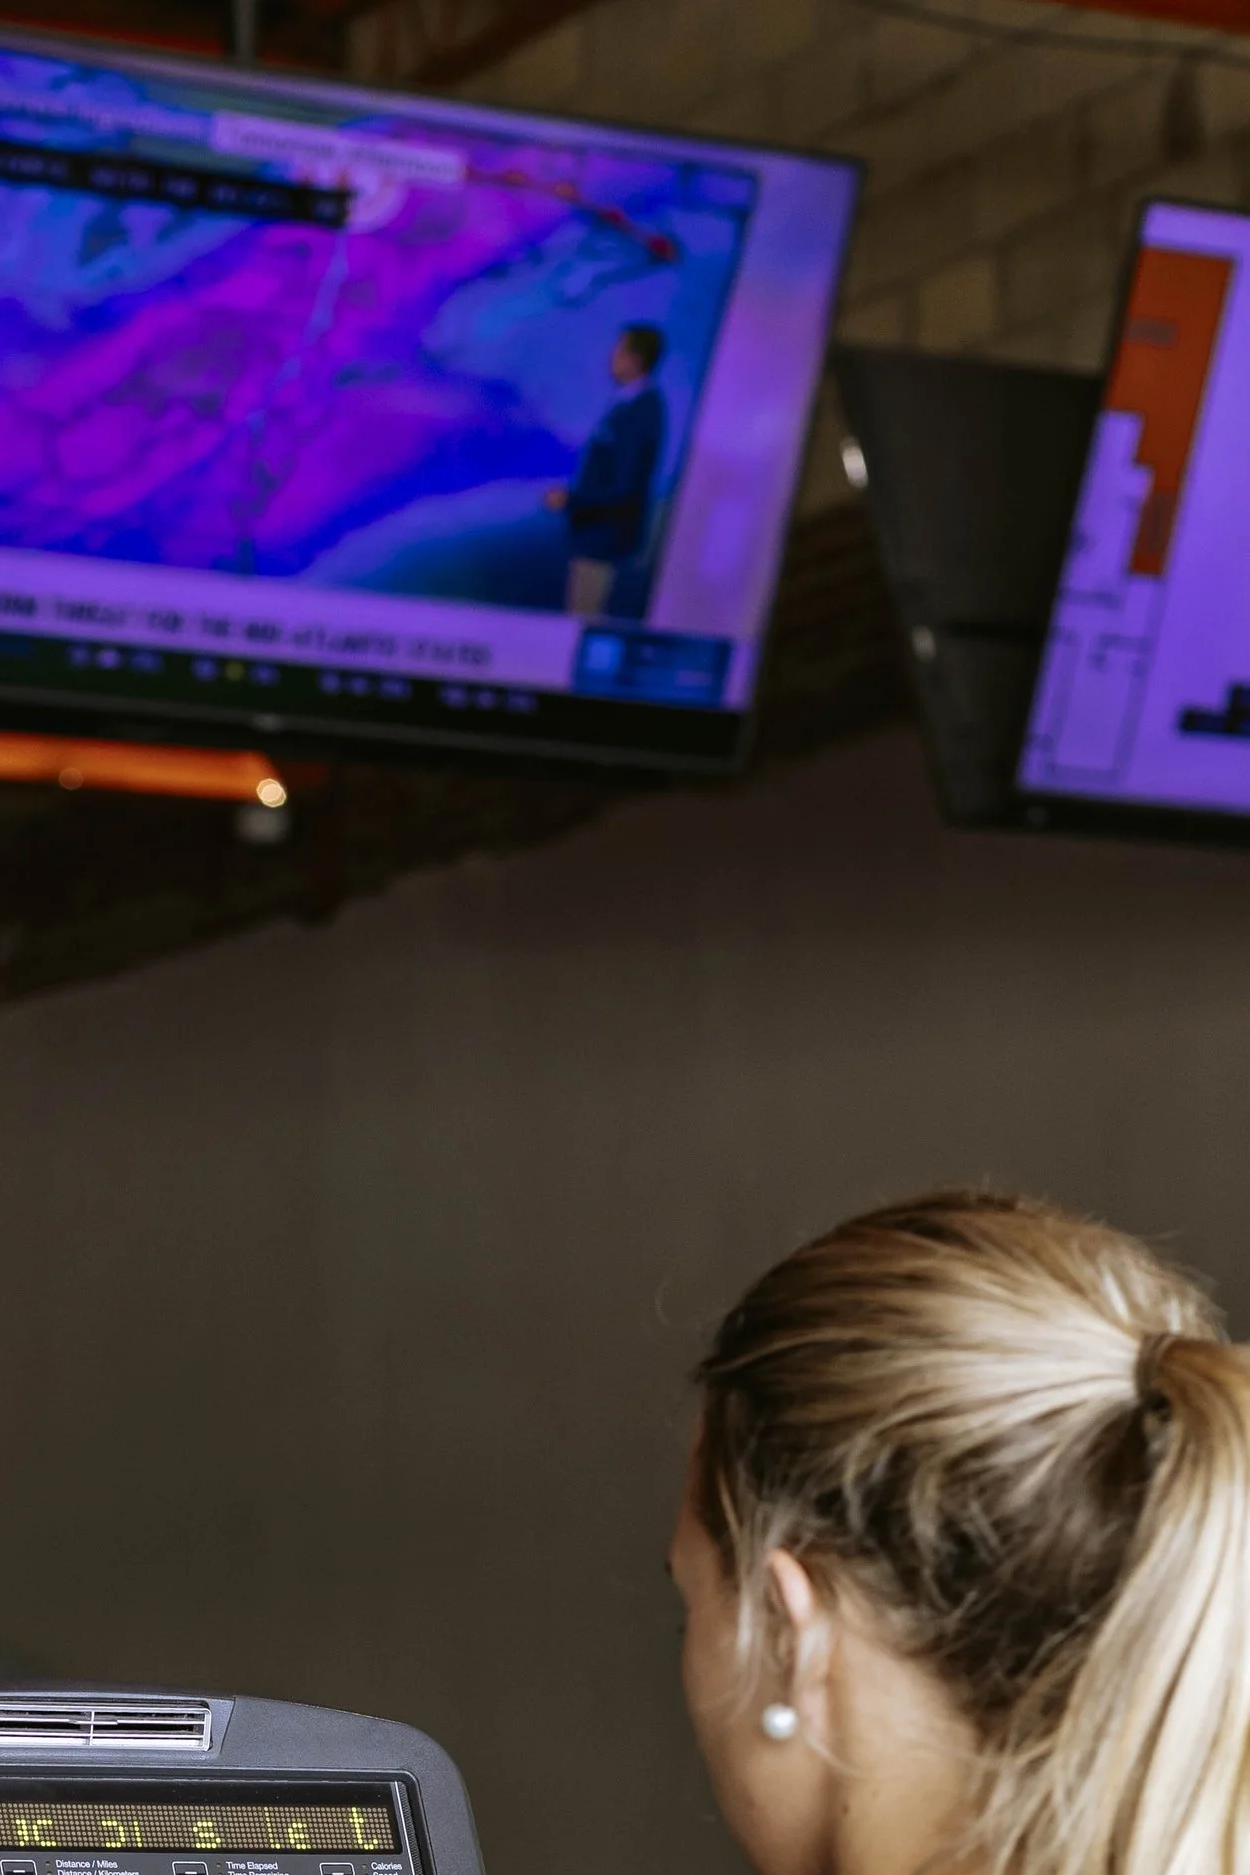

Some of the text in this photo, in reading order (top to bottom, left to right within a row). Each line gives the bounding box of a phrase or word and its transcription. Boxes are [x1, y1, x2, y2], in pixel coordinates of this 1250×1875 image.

[56, 1860, 91, 1869] Distance
[97, 1860, 118, 1869] Miles
[226, 1861, 278, 1872] Time Elapsed
[371, 1862, 402, 1871] Calories
